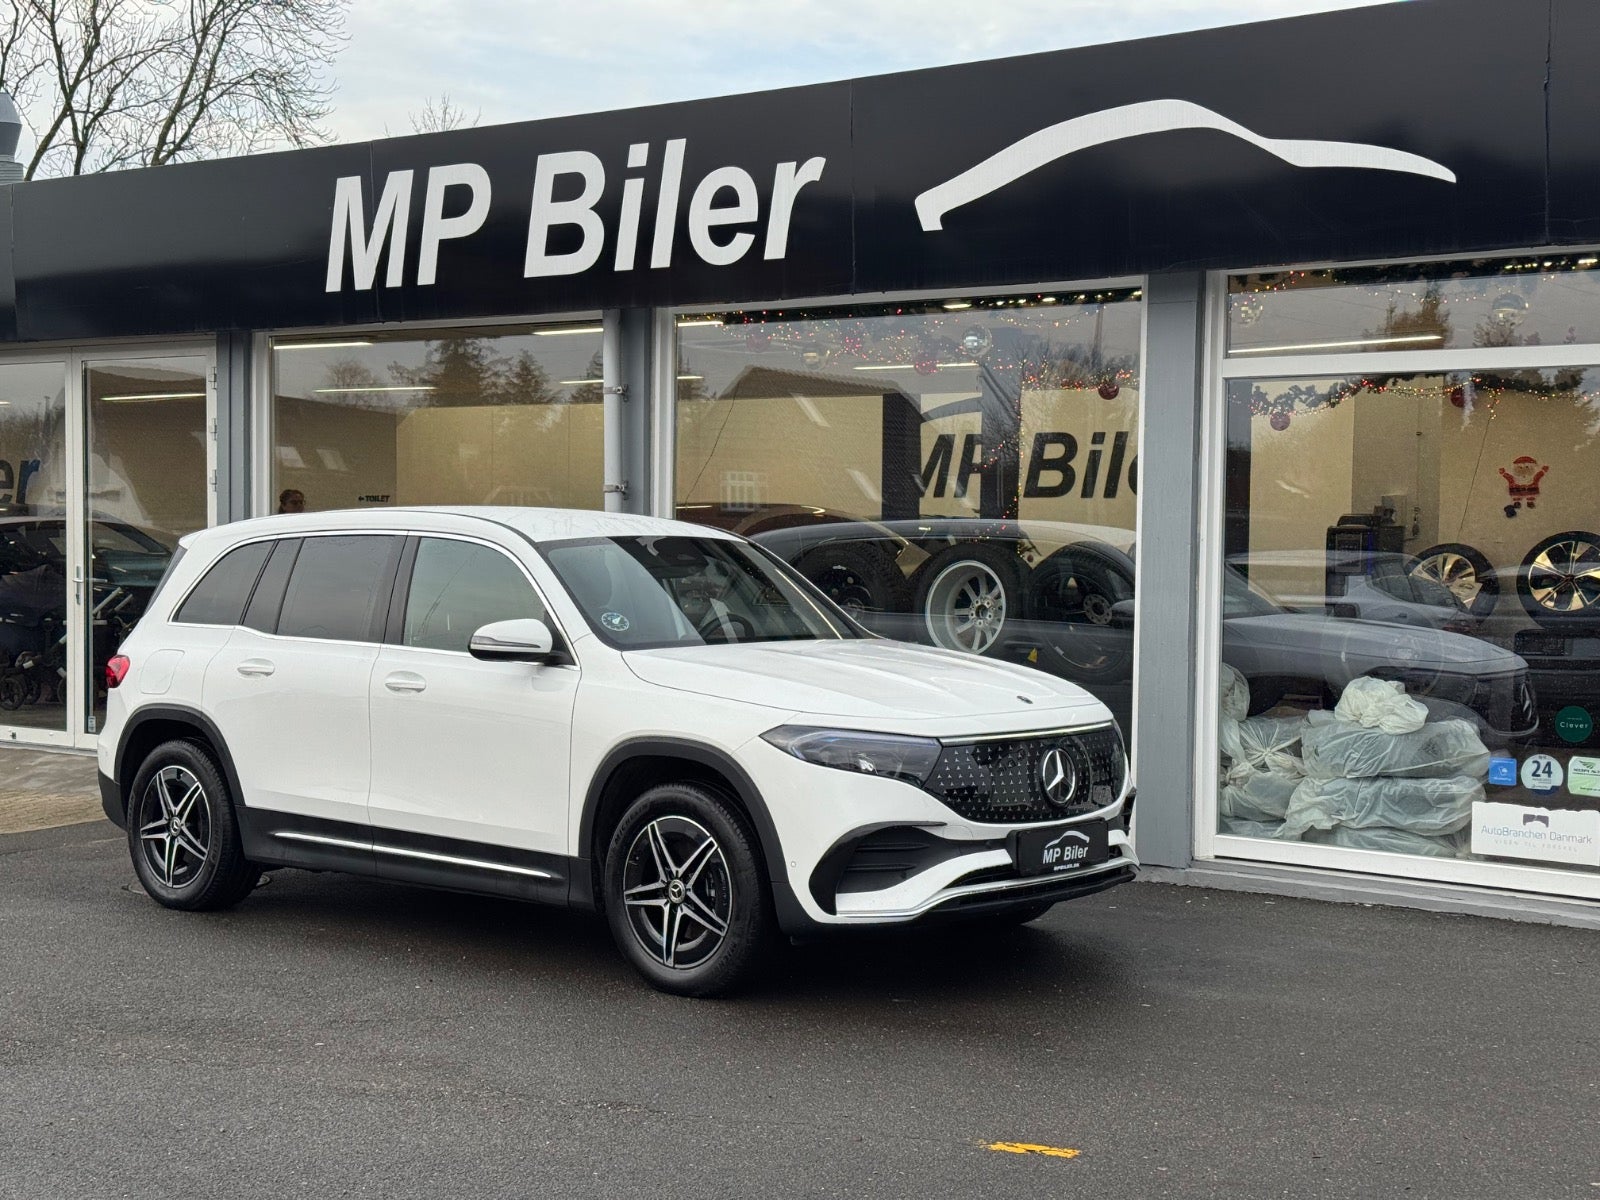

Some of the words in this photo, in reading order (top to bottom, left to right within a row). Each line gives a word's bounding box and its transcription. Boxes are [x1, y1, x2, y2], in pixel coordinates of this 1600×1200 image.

[325, 162, 492, 293] MP
[523, 138, 827, 278] Biler
[1023, 431, 1138, 499] Bil
[365, 495, 390, 503] TOILET
[1559, 721, 1588, 729] Clever
[1531, 760, 1553, 778] 24
[1481, 825, 1546, 840] AutoBranchen
[1549, 831, 1593, 844] Danmark
[1042, 848, 1061, 864] MP
[1064, 845, 1089, 860] Biler
